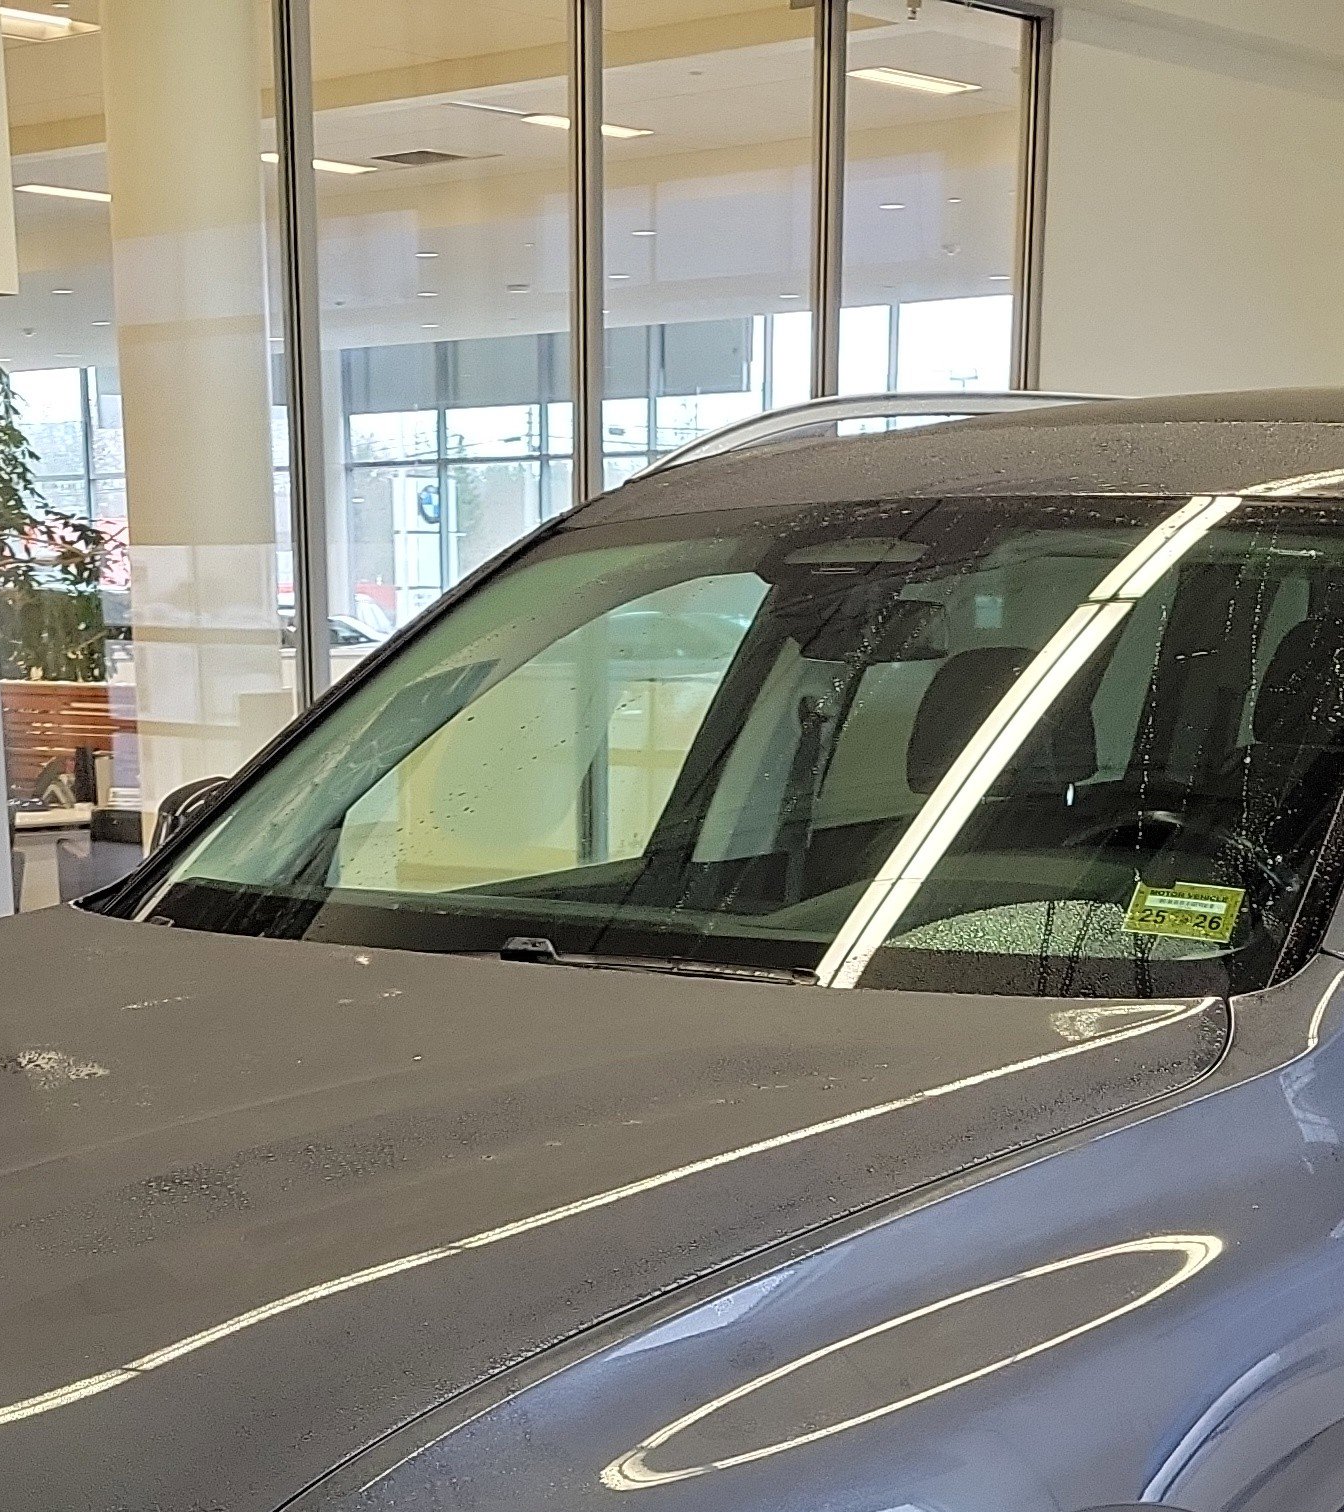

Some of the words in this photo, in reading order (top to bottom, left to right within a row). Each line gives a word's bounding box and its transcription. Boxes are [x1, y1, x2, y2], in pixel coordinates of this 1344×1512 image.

[1150, 889, 1185, 898] MOTOR
[1187, 892, 1229, 902] VEHICLE
[1138, 908, 1168, 925] 25
[1192, 913, 1223, 931] 26
